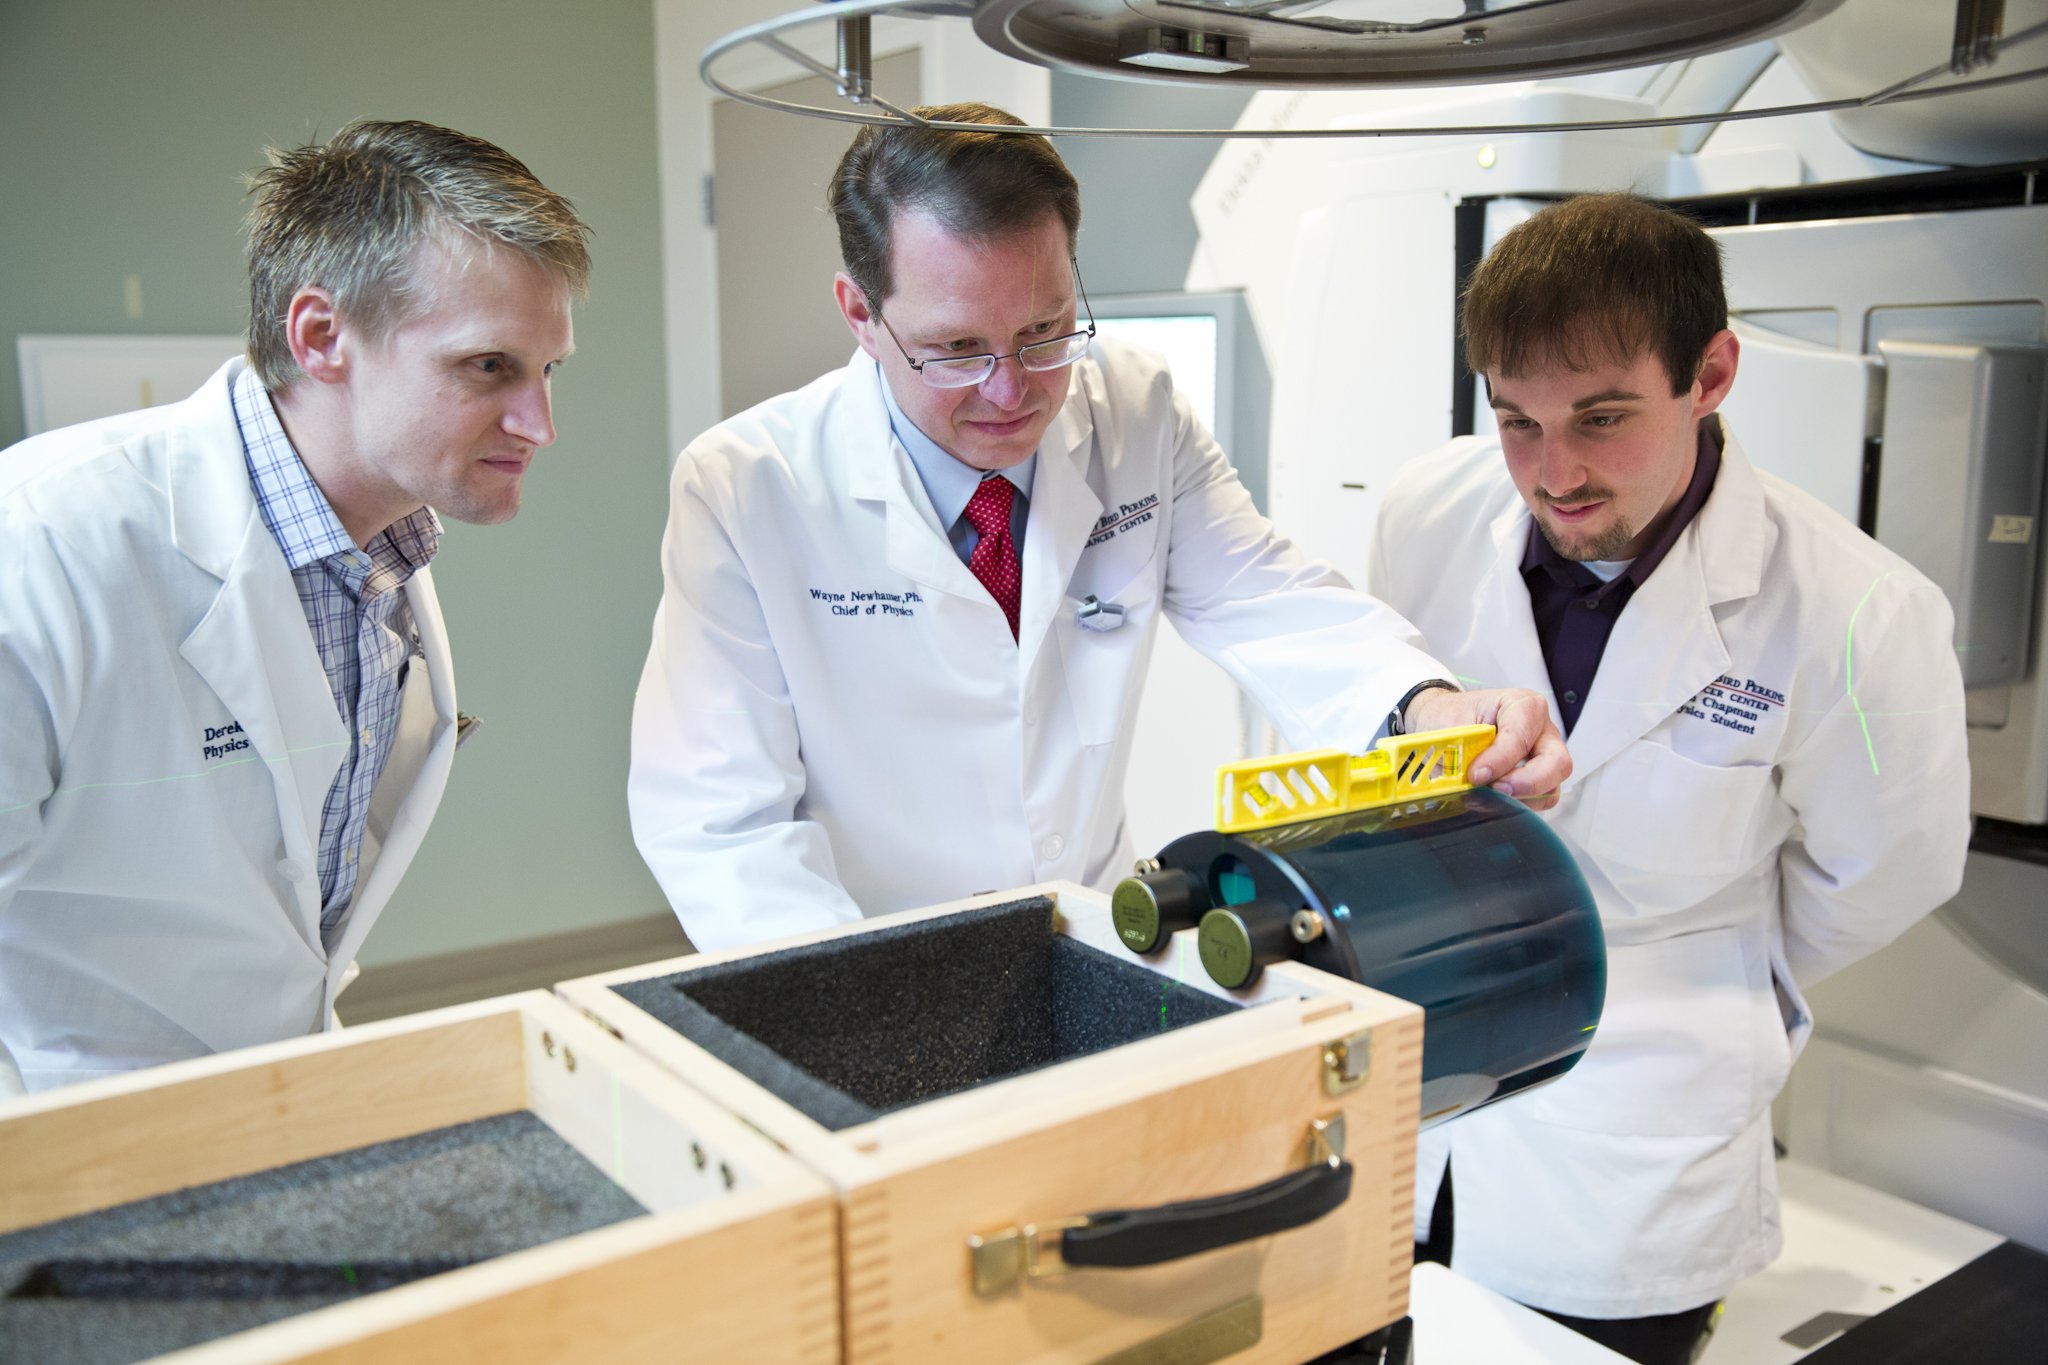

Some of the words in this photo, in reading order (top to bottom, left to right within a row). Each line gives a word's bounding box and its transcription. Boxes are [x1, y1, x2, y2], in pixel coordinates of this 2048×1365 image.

[1119, 493, 1158, 516] PERKINS
[1119, 512, 1153, 533] CENTER
[810, 589, 846, 602] Wayne
[832, 605, 859, 616] Chief
[866, 604, 876, 615] of
[882, 604, 914, 616] Physics
[1703, 686, 1724, 698] CER
[1730, 694, 1770, 712] CENTER
[1745, 679, 1785, 703] PERKINS
[1676, 704, 1705, 719] ysics
[1711, 713, 1755, 735] Student
[1702, 697, 1758, 721] Chapman
[204, 721, 244, 741] Derek
[203, 738, 249, 760] Physics
